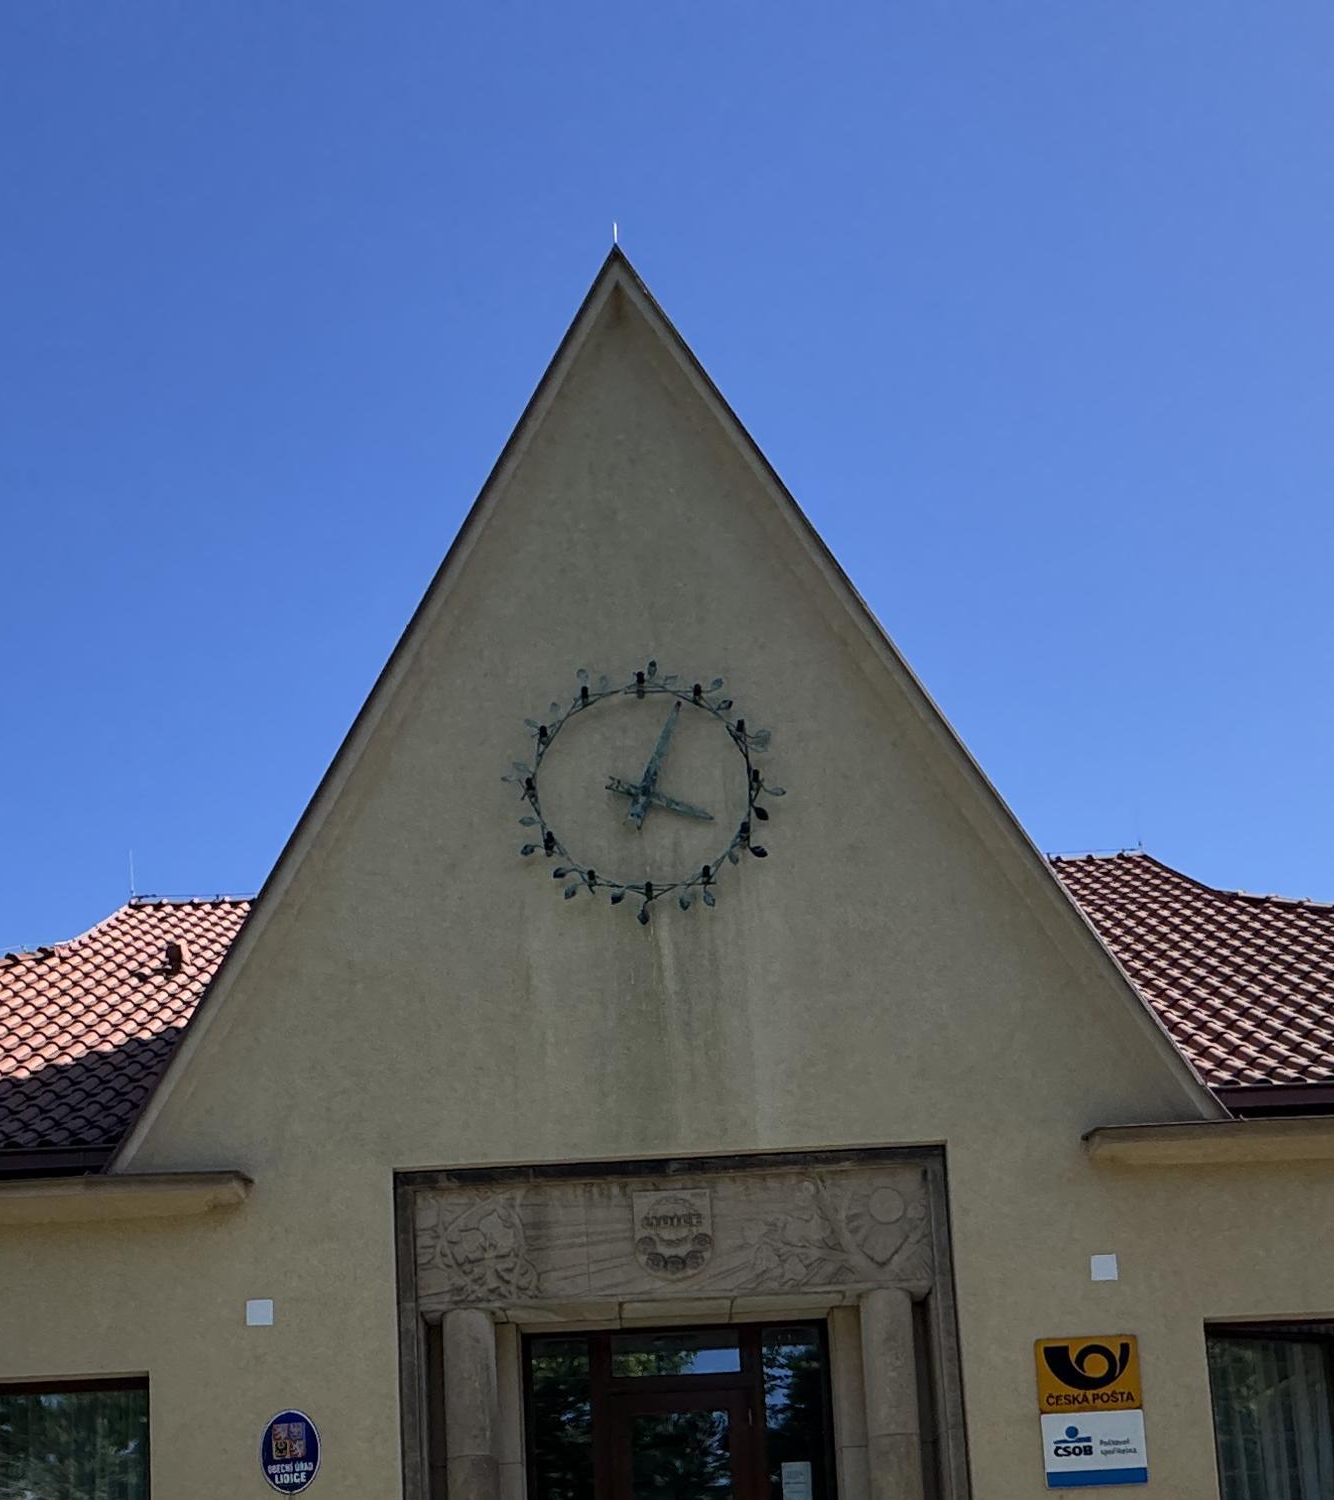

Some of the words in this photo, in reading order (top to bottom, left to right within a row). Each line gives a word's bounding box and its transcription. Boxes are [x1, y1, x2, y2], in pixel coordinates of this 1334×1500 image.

[1046, 1392, 1090, 1406] ČESKÁ
[1092, 1390, 1135, 1404] POŠTA
[275, 1472, 307, 1484] LIDICE
